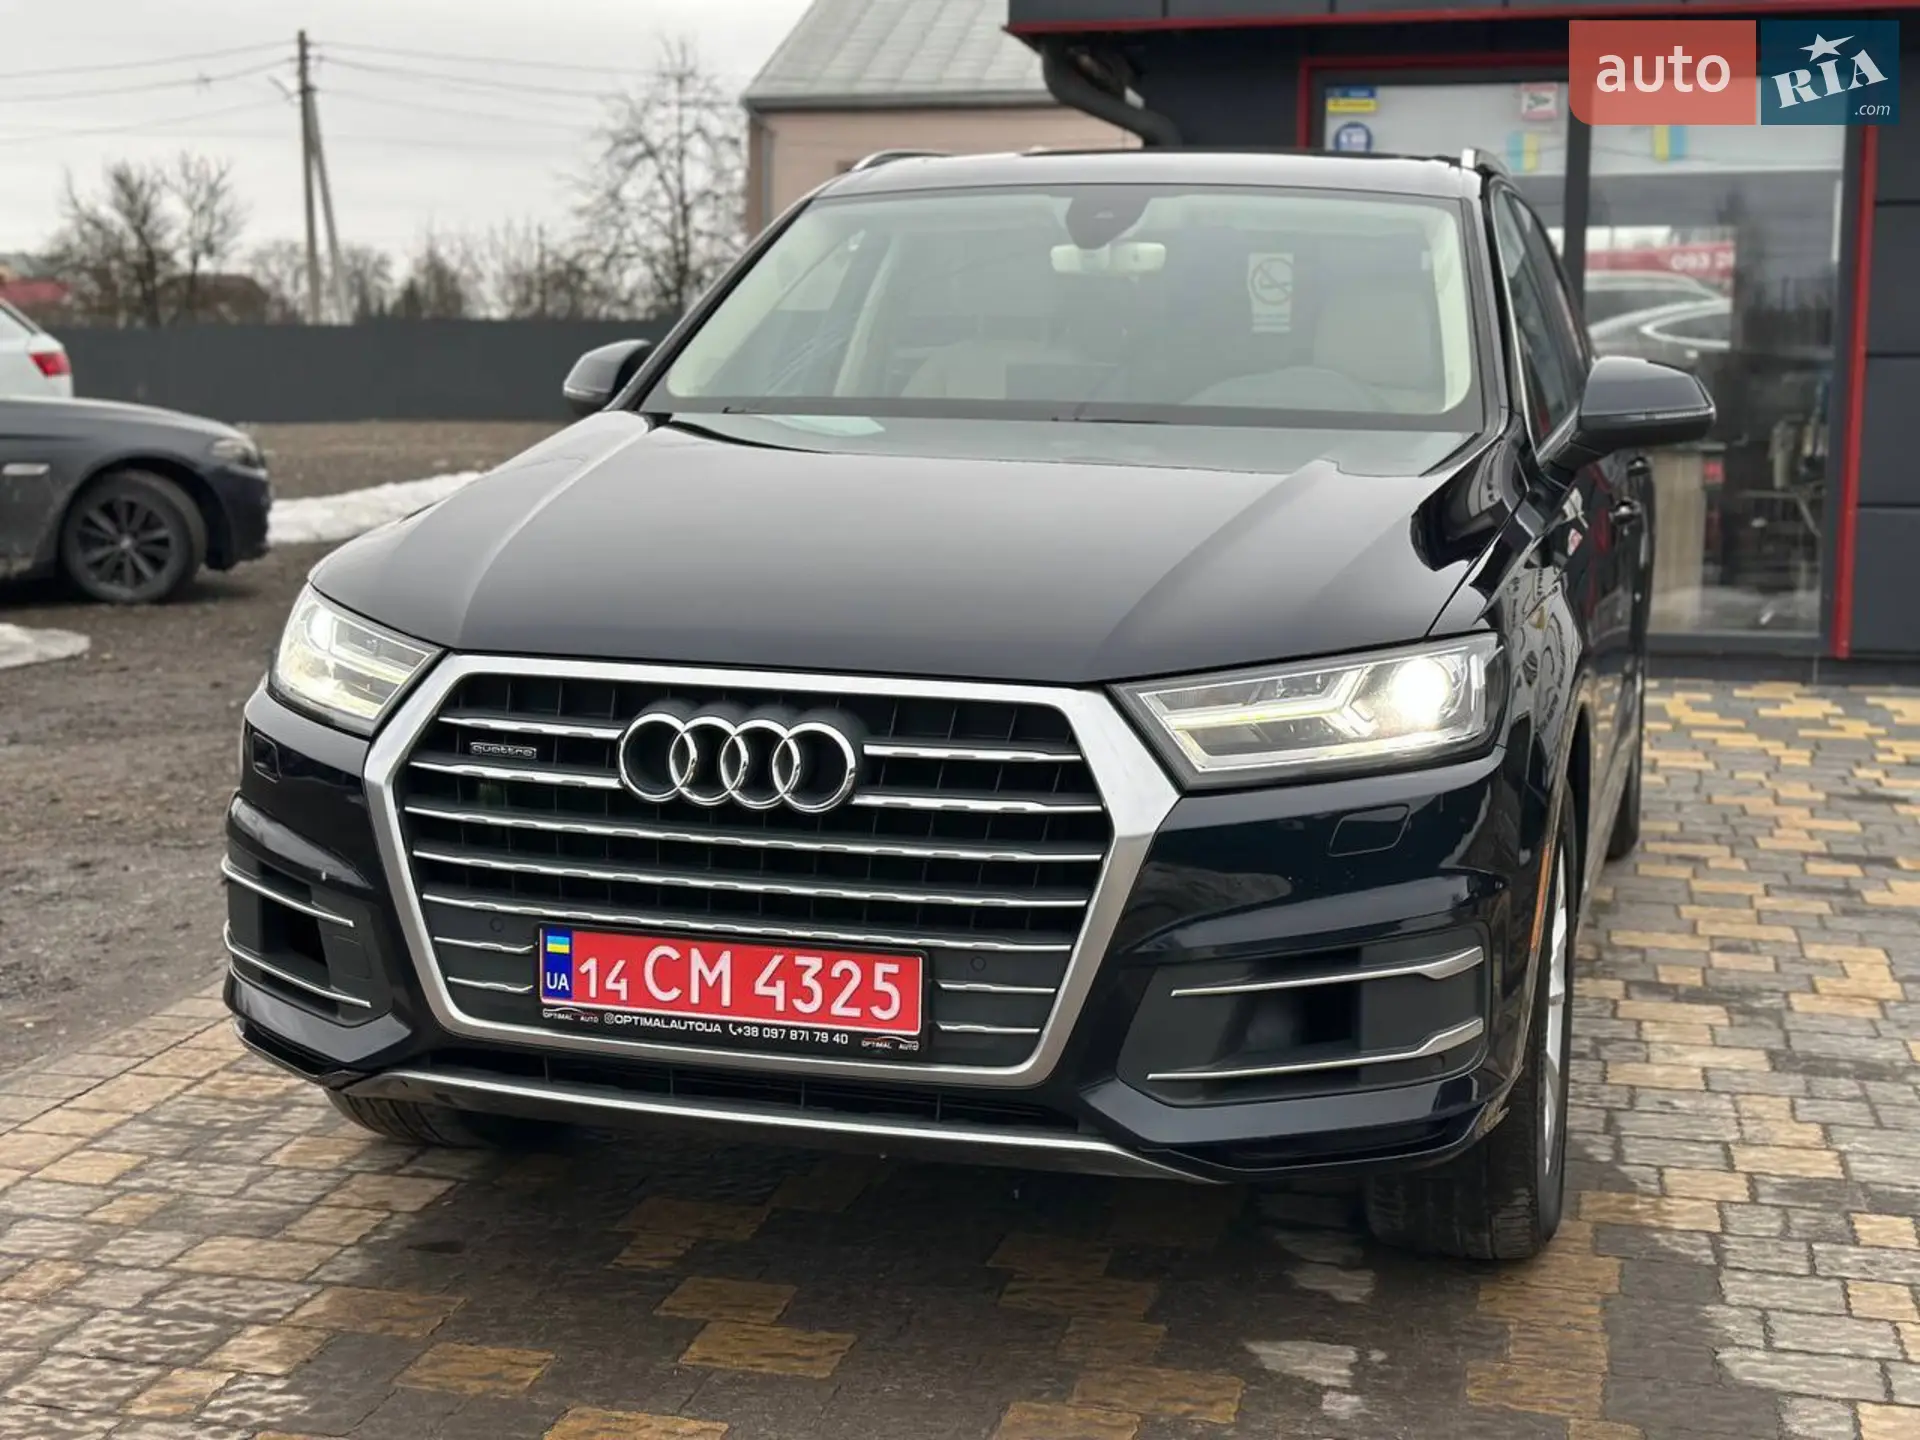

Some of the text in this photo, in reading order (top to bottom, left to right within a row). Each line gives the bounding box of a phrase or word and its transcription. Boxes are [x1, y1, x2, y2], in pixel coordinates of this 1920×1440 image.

[472, 744, 533, 757] quattro
[546, 972, 570, 990] UA
[579, 945, 901, 1020] 14 CM 4325
[543, 1010, 599, 1023] OPTIMAL AUTO
[762, 1027, 786, 1040] 097
[789, 1029, 810, 1041] 871
[813, 1031, 829, 1043] 79
[832, 1032, 849, 1045] 40
